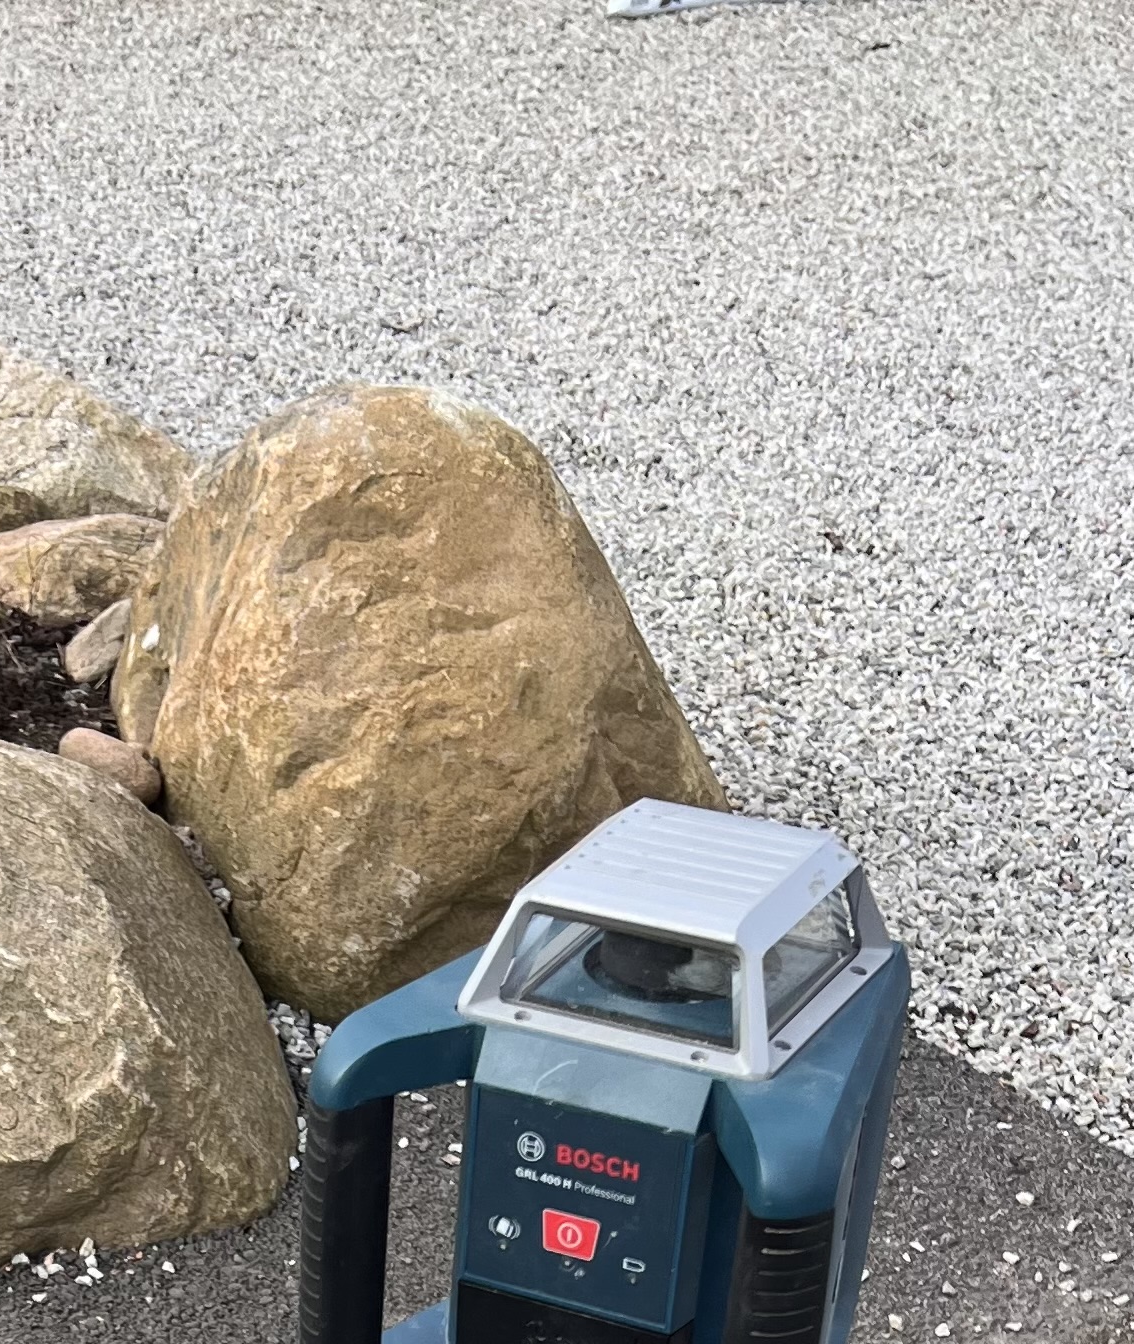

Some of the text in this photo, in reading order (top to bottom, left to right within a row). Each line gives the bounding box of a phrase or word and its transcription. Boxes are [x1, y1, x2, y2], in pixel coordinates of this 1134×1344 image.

[555, 1143, 640, 1183] BOSCH
[515, 1166, 538, 1182] GRL
[539, 1172, 561, 1187] 400
[573, 1181, 637, 1205] Professional
